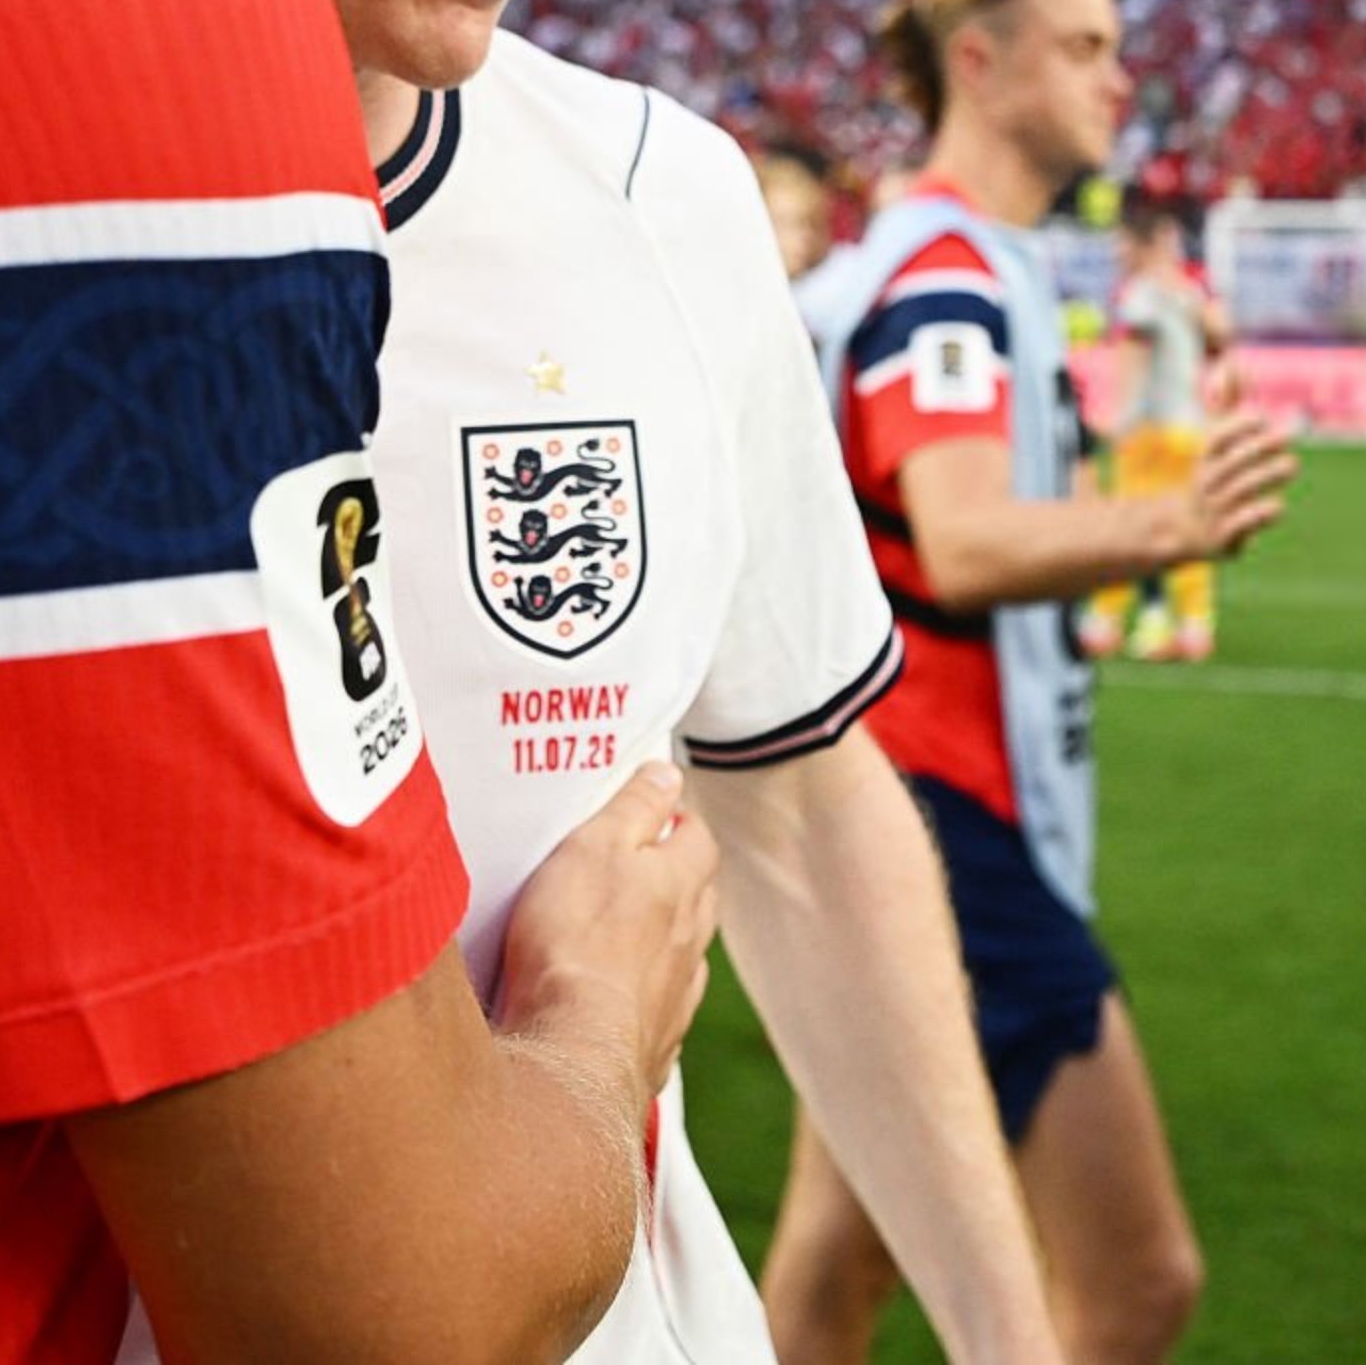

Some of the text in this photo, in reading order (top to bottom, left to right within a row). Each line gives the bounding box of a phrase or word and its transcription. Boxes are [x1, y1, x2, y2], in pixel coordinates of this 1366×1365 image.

[501, 684, 629, 726] NORWAY
[359, 705, 407, 776] 2026
[513, 735, 616, 774] 11.07.26
